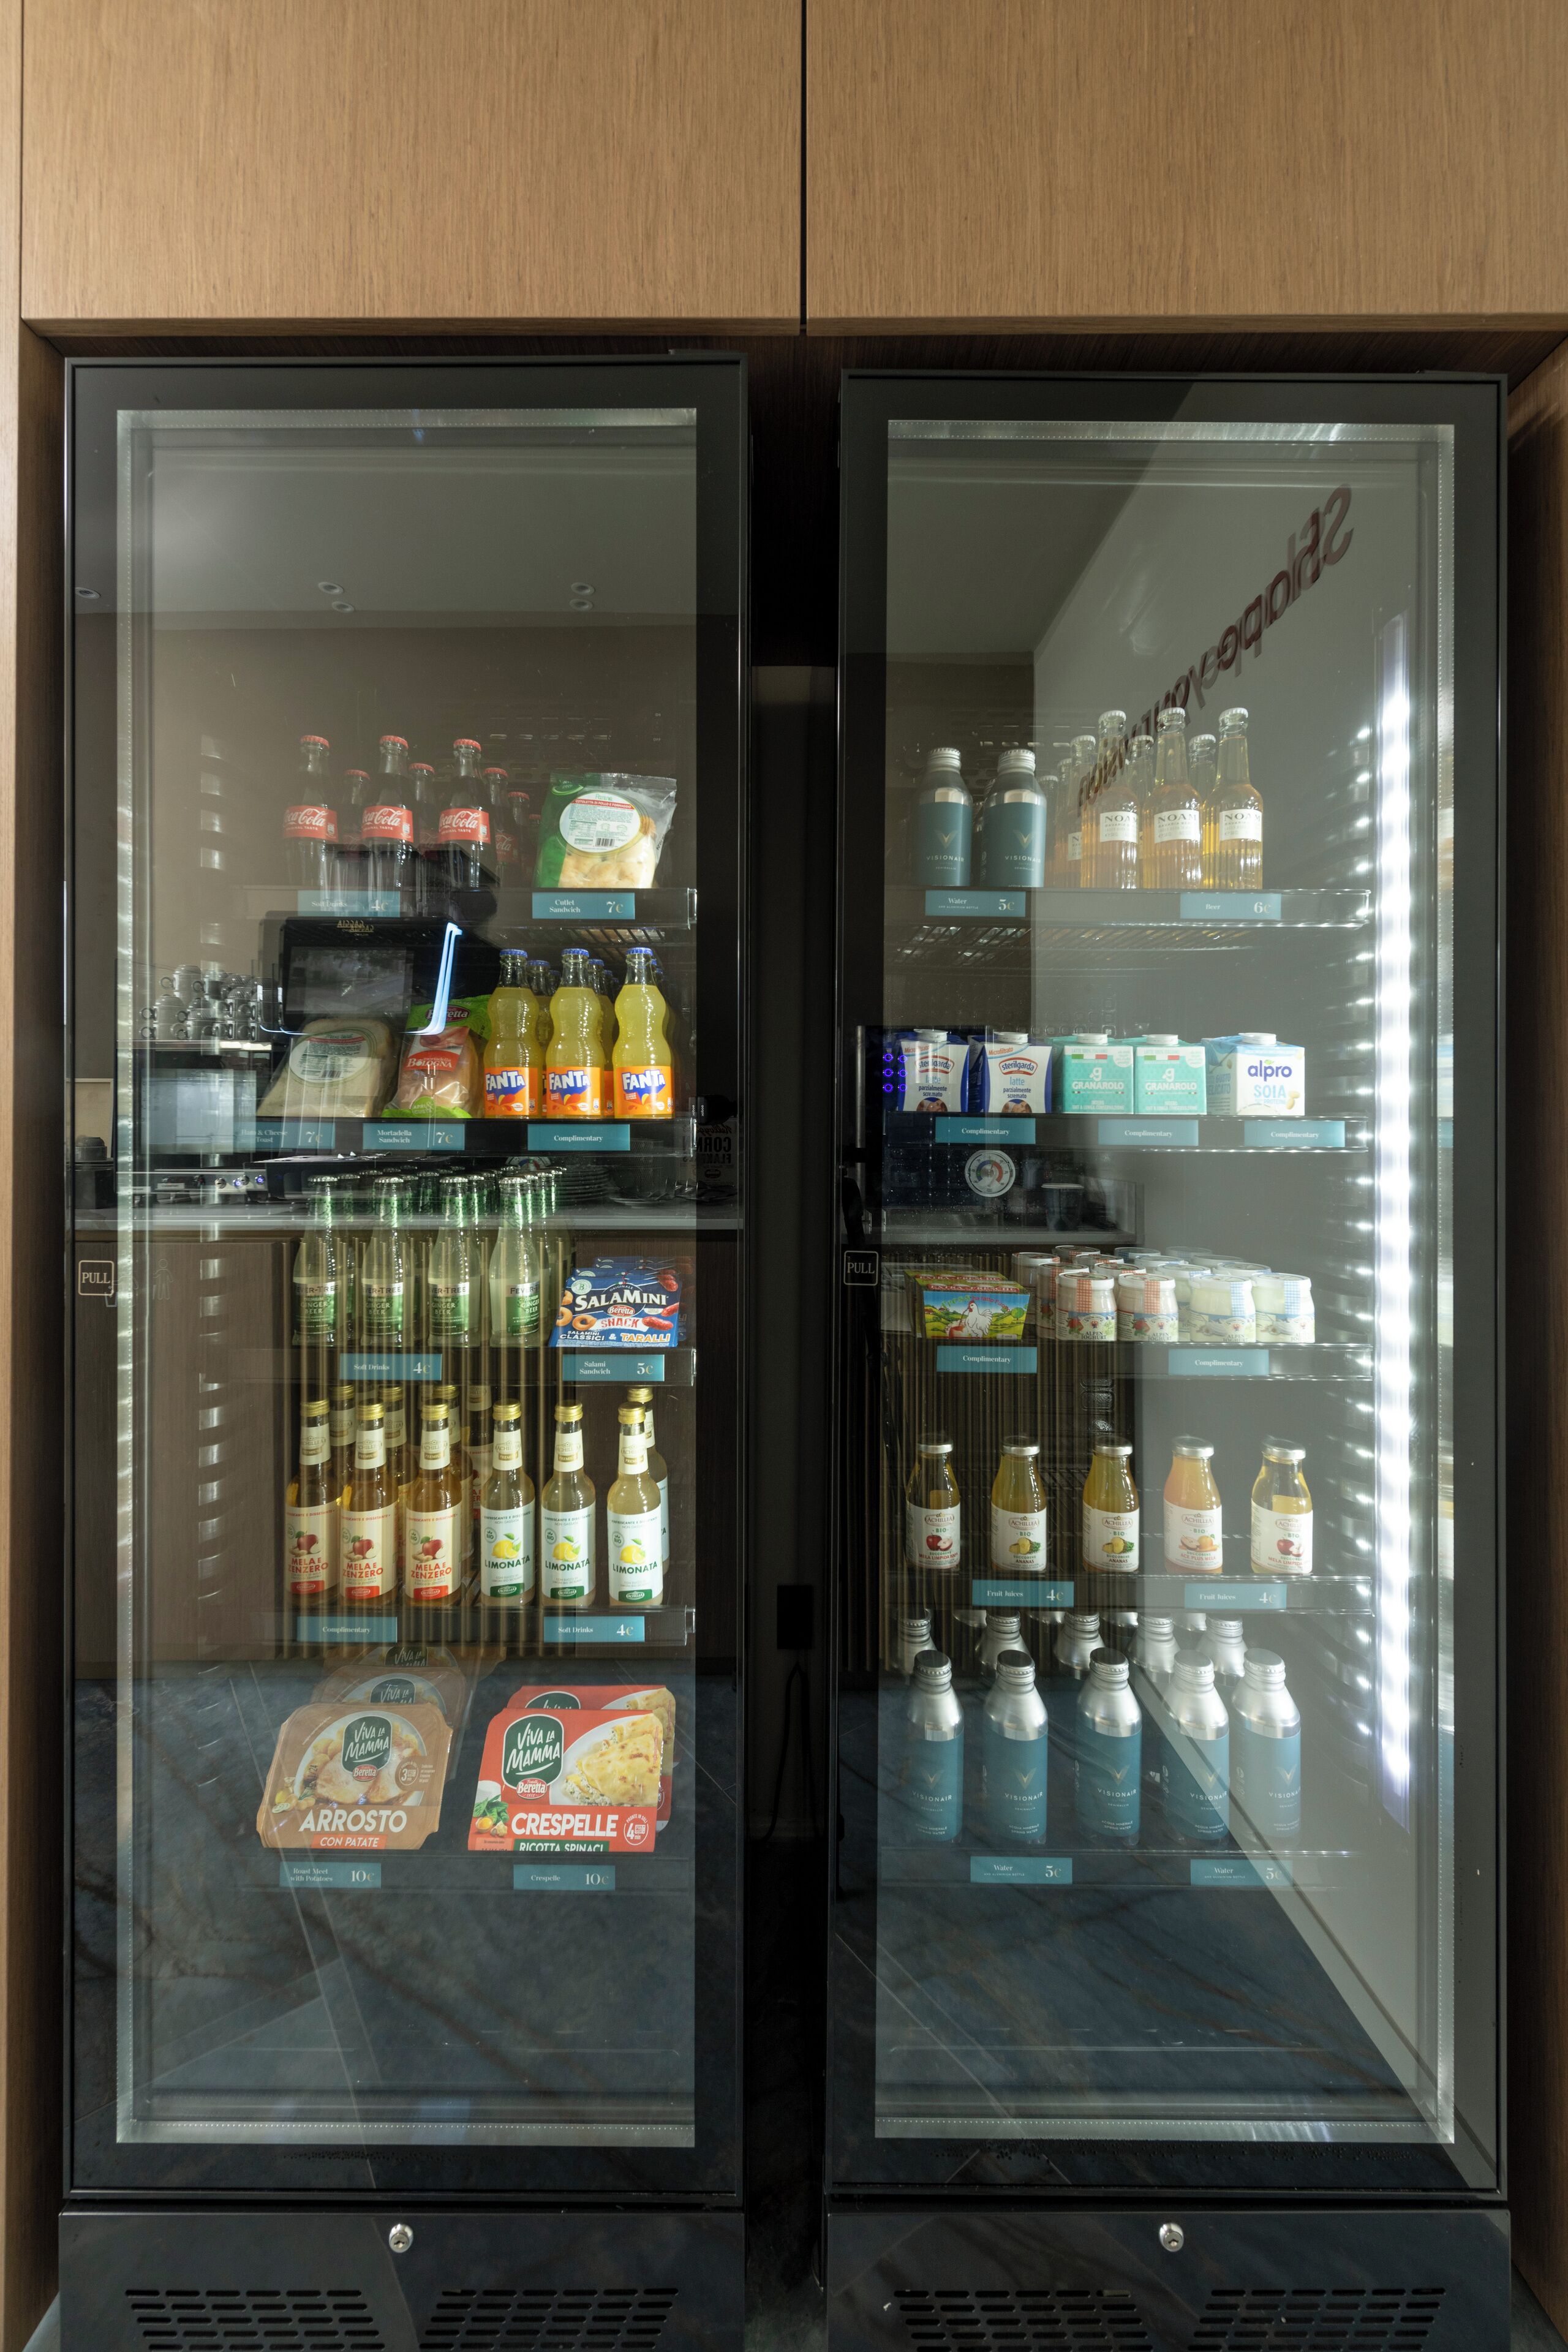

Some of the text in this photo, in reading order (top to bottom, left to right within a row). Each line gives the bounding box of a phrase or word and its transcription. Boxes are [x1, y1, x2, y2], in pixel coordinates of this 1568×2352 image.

[925, 854, 964, 863] VISIONAIR
[1005, 854, 1041, 864] VISIONAIR
[989, 1047, 1014, 1056] Microfiltrato
[407, 1058, 453, 1068] BOLOGNA
[1001, 1060, 1035, 1072] sterilgarda
[1248, 1060, 1292, 1082] alpro
[486, 1070, 526, 1091] FANTA
[549, 1070, 590, 1091] FANTA
[622, 1069, 666, 1091] FANTA
[1009, 1077, 1025, 1085] latte
[919, 1084, 947, 1093] parzialmente
[1072, 1082, 1125, 1091] GRANAROLO
[1145, 1083, 1197, 1093] GRANAROLO
[1253, 1084, 1286, 1098] SOIA
[961, 1128, 1010, 1136] Complimentary
[554, 1135, 603, 1144] Complimentary
[847, 1262, 875, 1274] PULL
[81, 1272, 111, 1284] PULL
[295, 1285, 339, 1294] EVER-TREE
[521, 1298, 539, 1308] GINGER
[575, 1289, 667, 1312] SALAMINI
[608, 1306, 634, 1316] Beretta
[600, 1317, 640, 1329] SNACK
[559, 1333, 605, 1342] CLASSICI
[620, 1332, 671, 1343] TARALLI
[962, 1355, 1011, 1364] Complimentary
[291, 1558, 314, 1567] MELA
[346, 1562, 371, 1571] MELA
[415, 1562, 441, 1572] MELA
[484, 1555, 530, 1569] LIMONATA
[545, 1558, 590, 1572] LIMONATA
[612, 1561, 658, 1574] LIMONATA
[287, 1562, 329, 1574] ZENZERO
[342, 1567, 384, 1578] ZENZERO
[410, 1567, 452, 1580] ZENZERO
[377, 1727, 385, 1738] LA
[545, 1730, 555, 1743] LA
[345, 1736, 390, 1762] MAMMA
[505, 1741, 561, 1774] MAMMA
[353, 1768, 377, 1777] Beretta
[401, 1768, 409, 1782] 3
[516, 1781, 546, 1795] Beretta
[1097, 1787, 1137, 1798] VISIONAIR
[911, 1790, 952, 1803] VISIONAIR
[1005, 1791, 1043, 1801] VISIONAIR
[1190, 1790, 1227, 1801] VISIONAIR
[298, 1809, 408, 1833] ARROSTO
[511, 1812, 620, 1838] CRESPELLE
[626, 1822, 635, 1840] 4
[320, 1836, 380, 1848] CON PATATE
[519, 1842, 604, 1852] RICOTTA SPINACI
